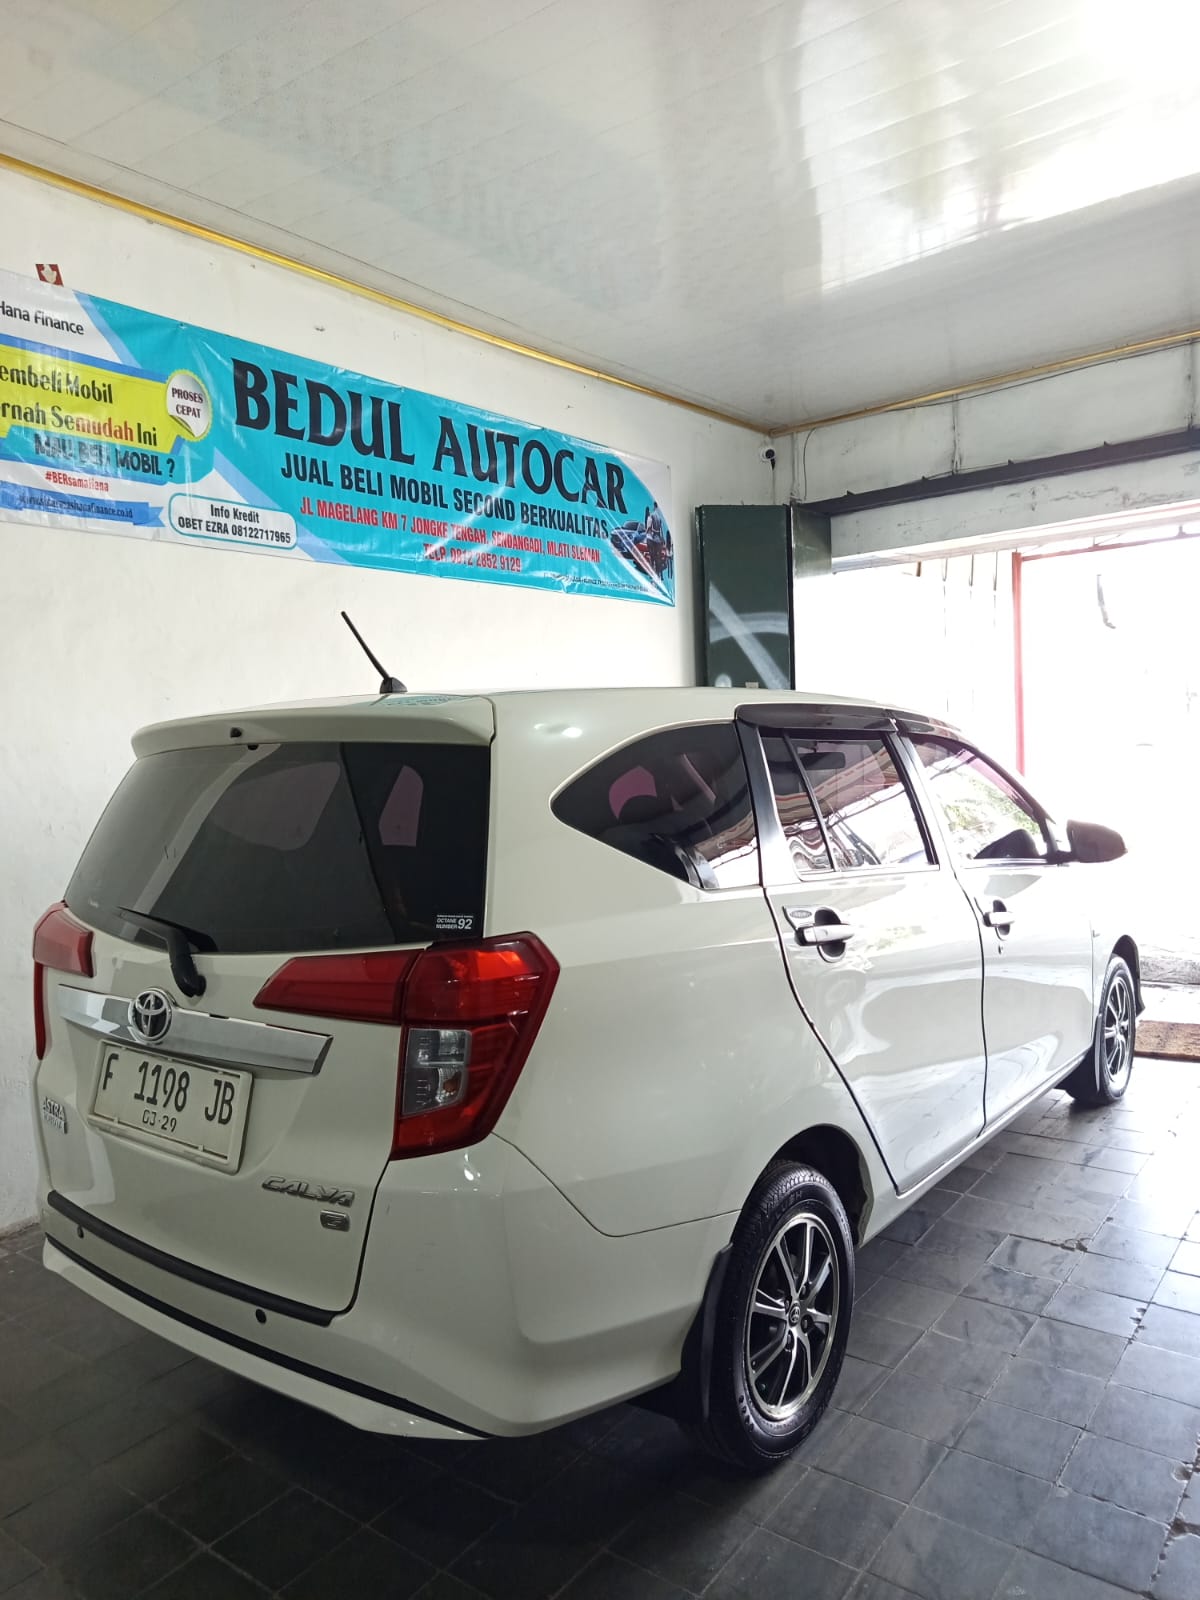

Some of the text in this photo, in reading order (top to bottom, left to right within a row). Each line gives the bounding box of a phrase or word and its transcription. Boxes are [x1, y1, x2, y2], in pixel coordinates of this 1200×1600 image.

[34, 310, 84, 335] Finance
[66, 373, 113, 404] Mobil
[171, 387, 204, 404] PROSES
[0, 401, 157, 446] rnah Semudah Ini
[176, 404, 202, 419] CEPAT
[231, 357, 628, 515] BEDUL AUTOCAR
[115, 448, 162, 476] MOBIL
[281, 452, 609, 539] JUAL BELI MOBIL SECOND BERKUALITAS
[210, 504, 260, 524] Info Kredit
[178, 516, 291, 544] OBET EZRA 08122717965
[300, 497, 313, 515] JL
[317, 499, 378, 526] MAGELANG
[381, 511, 398, 530] KM
[401, 515, 407, 531] 7
[411, 517, 448, 538] JONGKE
[547, 541, 570, 558] MLATI
[572, 544, 601, 563] SLEMAN
[476, 552, 498, 569] 2852
[501, 555, 521, 572] 9129
[458, 918, 473, 930] 92
[102, 1053, 235, 1125] F 1198 JB
[261, 1176, 356, 1208] CALYA
